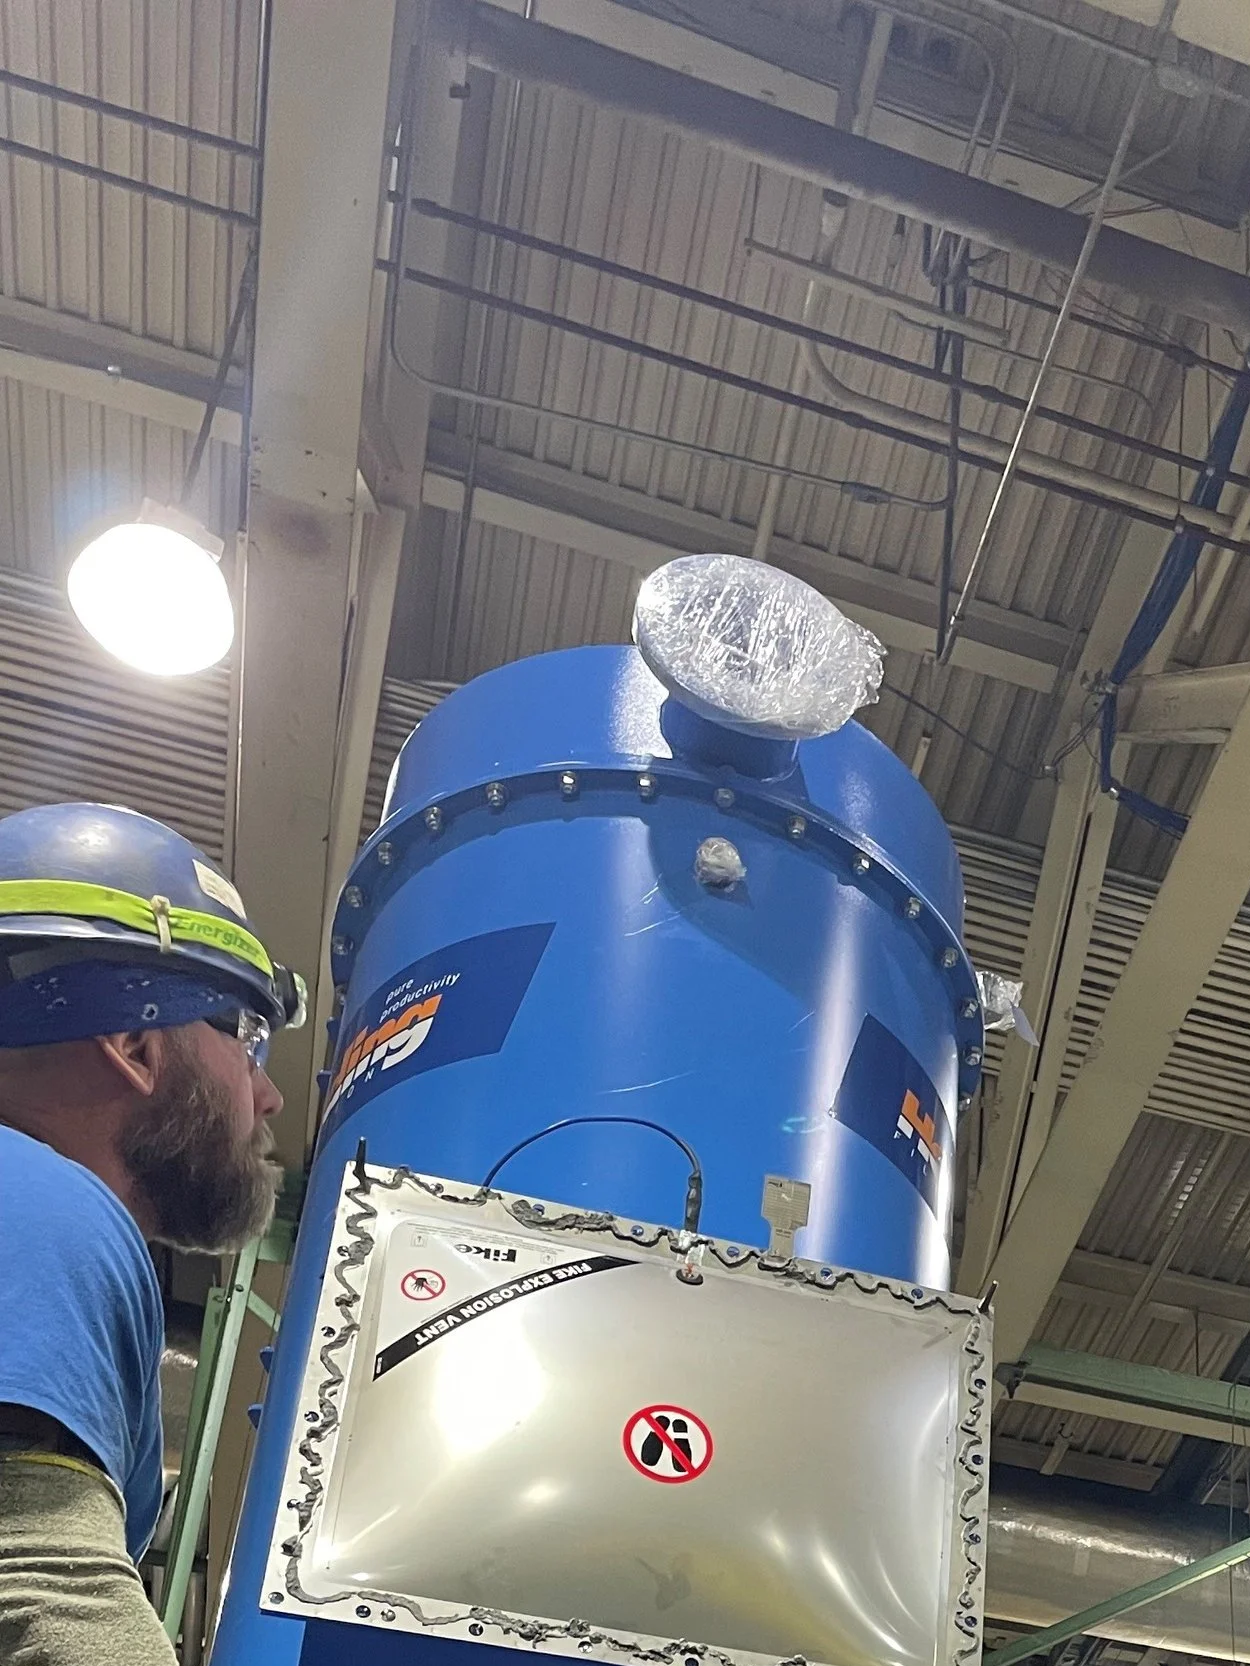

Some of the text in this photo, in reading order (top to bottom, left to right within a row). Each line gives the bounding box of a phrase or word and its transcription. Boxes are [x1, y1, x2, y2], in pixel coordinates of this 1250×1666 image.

[379, 973, 460, 1023] productivity
[386, 979, 413, 1005] pure
[456, 1243, 517, 1264] Fike
[555, 1261, 593, 1281] FIKE
[459, 1274, 557, 1319] EXPLOSION
[414, 1313, 462, 1346] VENT
